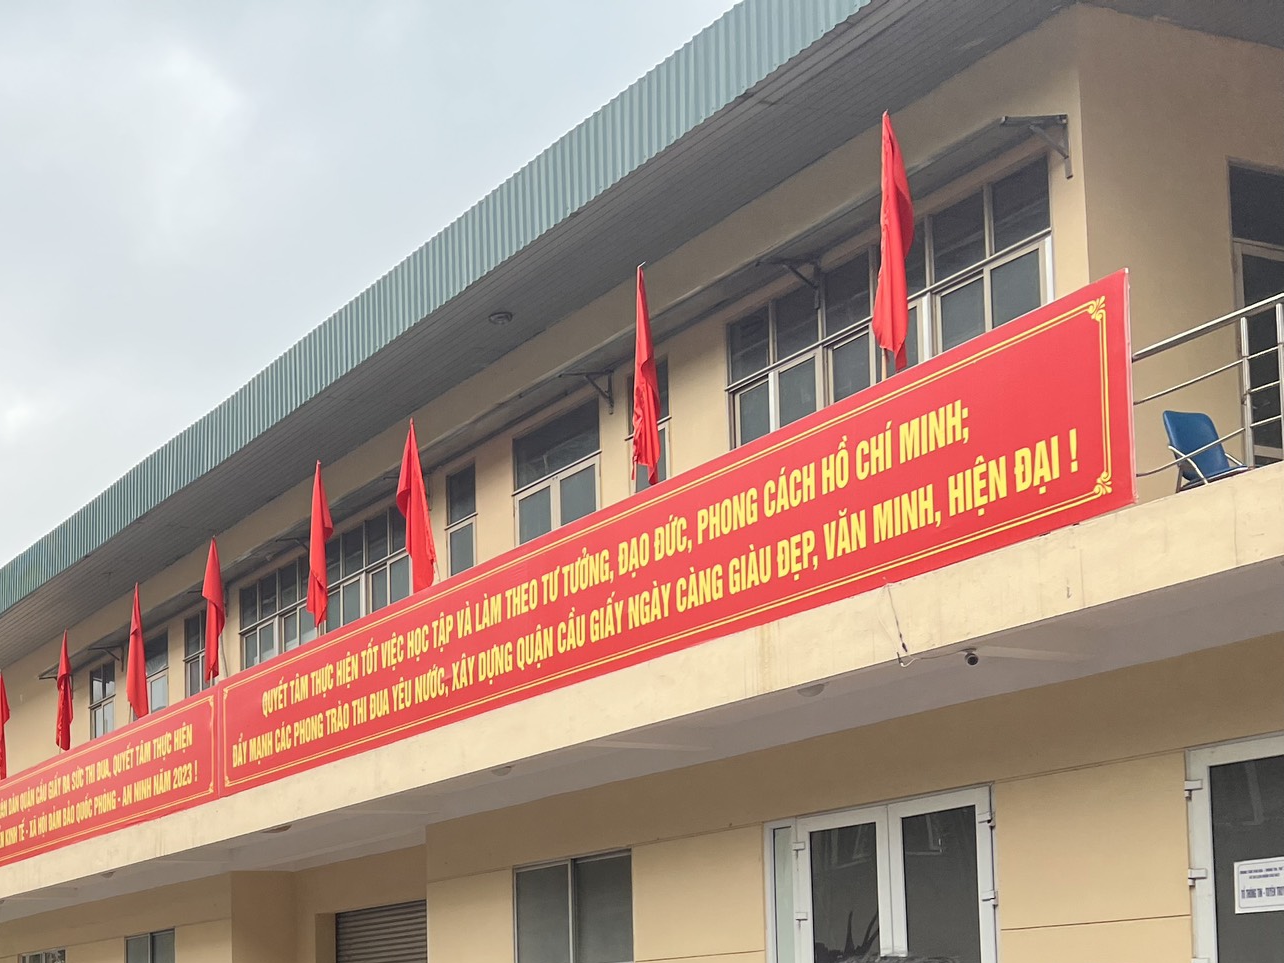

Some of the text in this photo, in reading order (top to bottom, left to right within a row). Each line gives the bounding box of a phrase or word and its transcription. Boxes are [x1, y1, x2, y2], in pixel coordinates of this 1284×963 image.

[232, 428, 1078, 767] ĐẨY MẠNH CÁC PHONG TRÀO THI ĐUA YÊU NƯỚC, XÂY DỰNG QUẬN CẦU GIẤY NGÀY CÀNG GIÀU ĐẸP, VĂN MINH, HIỆN ĐẠI !
[261, 399, 968, 717] QUYẾT TÂM THỰC HIỆN TỐT VIỆC HỌC TẬP VÀ LÀM THEO TƯ TƯỞNG, ĐẠO ĐỨC, PHONG CÁCH HỒ CHÍ MINH;
[17, 817, 25, 841] TẾ
[28, 815, 37, 838] XÃ
[37, 811, 47, 837] HỘI
[47, 805, 61, 831] ĐẢM
[62, 799, 74, 826] BẢO
[75, 792, 92, 823] QUỐC
[93, 788, 116, 815] PHÒNG
[121, 783, 132, 806] AN
[133, 776, 151, 802] NINH
[153, 767, 171, 795] NĂM
[172, 762, 192, 789] 2023
[194, 759, 197, 781] !
[35, 778, 47, 804] CẦU
[47, 771, 61, 799] GIẤY
[61, 773, 70, 794] RA
[71, 765, 84, 790] SỨC
[84, 763, 95, 785] THI
[96, 757, 111, 781] ĐUA,
[112, 742, 134, 776] QUYẾT
[135, 739, 151, 766] TÂM
[152, 731, 172, 760] THỰC
[173, 721, 192, 752] HIỆN
